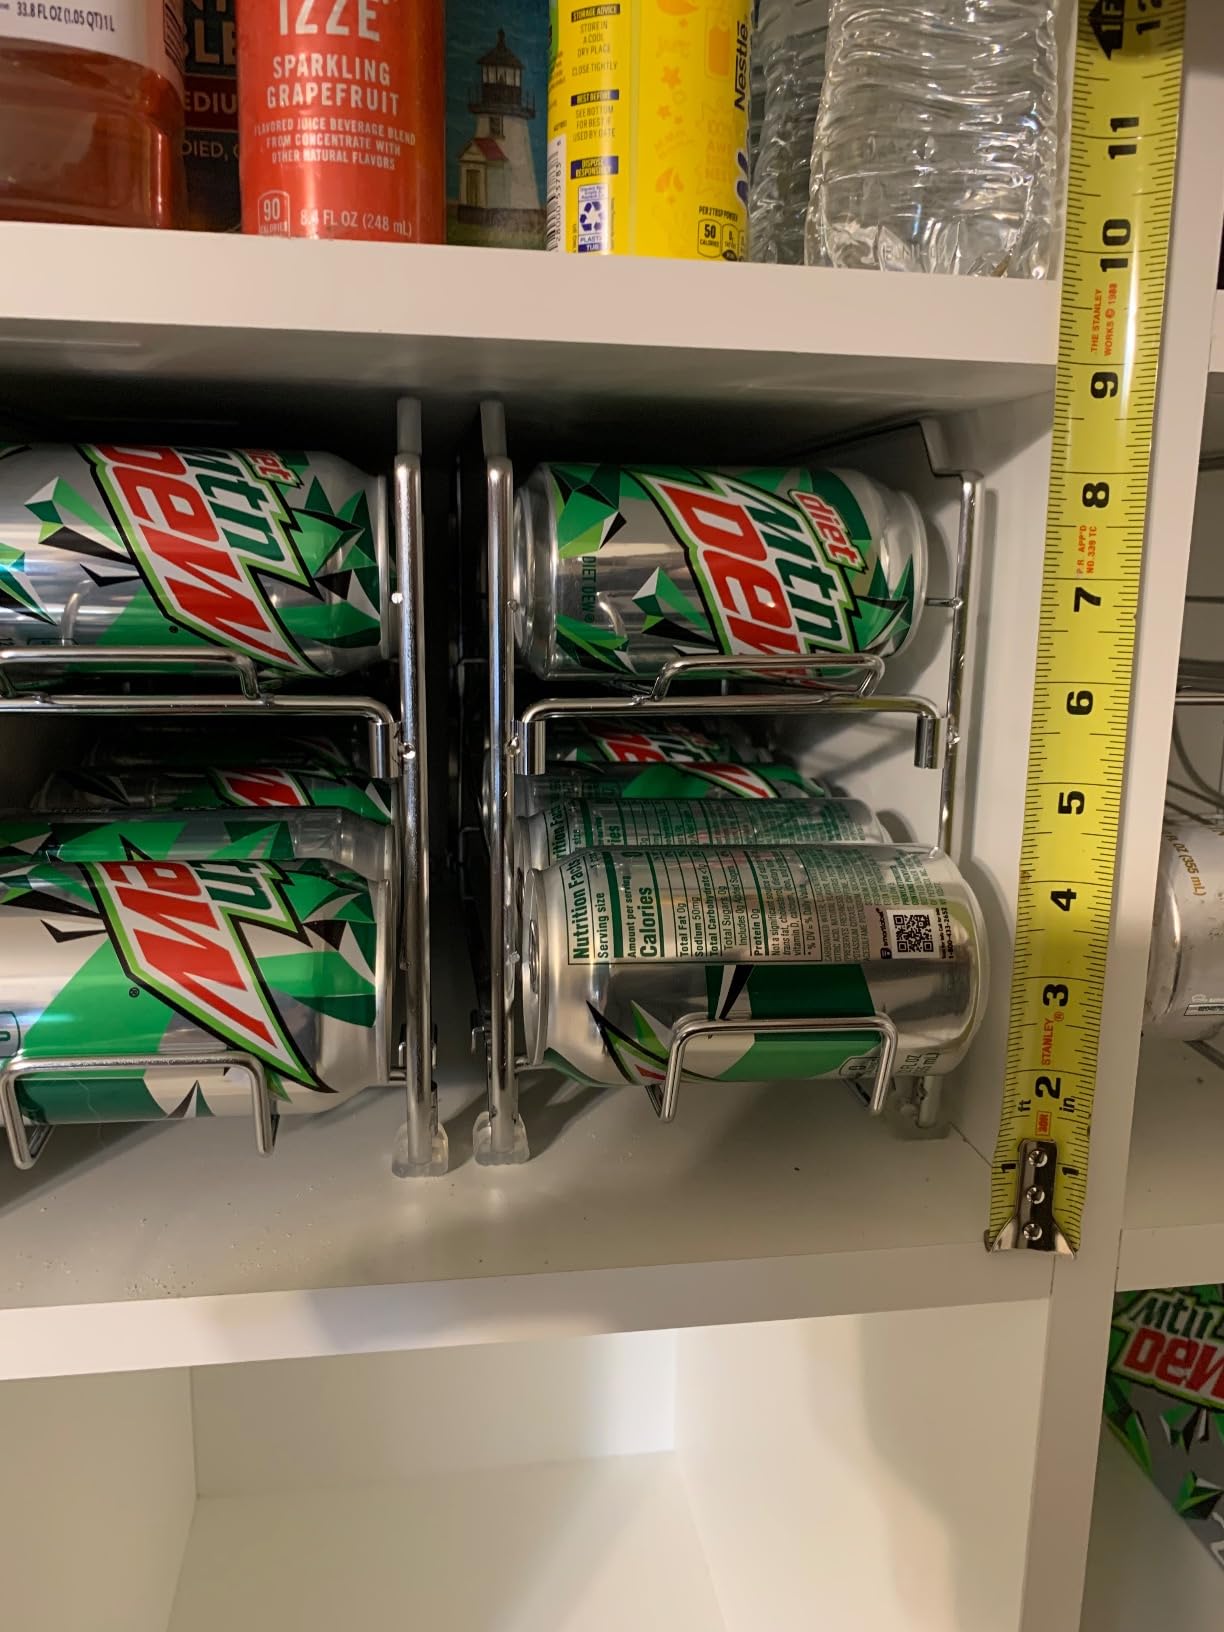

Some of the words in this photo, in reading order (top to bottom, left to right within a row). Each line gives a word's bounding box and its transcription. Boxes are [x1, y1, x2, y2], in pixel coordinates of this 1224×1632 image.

[17, 1, 35, 17] 33.8
[37, 3, 48, 20] FL
[49, 5, 62, 22] OZ
[64, 8, 85, 25] (1.05
[597, 4, 617, 15] ADVICE
[577, 46, 589, 58] DRY
[273, 52, 391, 88] SPARKLING
[572, 63, 590, 76] CLOSE
[267, 82, 400, 117] GRAPEFRUIT
[254, 118, 293, 137] FLAVORED
[298, 117, 326, 131] JUICE
[330, 117, 385, 136] BEVERAGE
[387, 127, 417, 147] BLEND
[576, 119, 587, 128] FOR
[266, 134, 292, 149] FROM
[295, 132, 371, 150] CONCENTRATE
[375, 139, 402, 157] WITH
[1108, 116, 1140, 160] 11
[271, 151, 300, 165] OTHER
[303, 148, 348, 163] NATURAL
[352, 151, 396, 171] FLAVORS
[263, 198, 281, 222] 90
[323, 208, 339, 226] FL
[341, 211, 359, 228] OZ
[362, 213, 389, 232] (248
[393, 220, 413, 238] mL)
[704, 223, 716, 239] 50
[1099, 218, 1131, 273] 10
[1093, 289, 1102, 332] STANLEY
[1091, 333, 1100, 353] THE
[1104, 320, 1114, 357] WORKS
[1090, 371, 1118, 399] 9
[1081, 481, 1110, 509] 8
[582, 556, 596, 583] DIET
[582, 586, 596, 612] DEW
[1073, 587, 1101, 613] 7
[1066, 690, 1094, 716] 6
[1057, 790, 1086, 815] 5
[568, 858, 585, 887] Facts
[1178, 854, 1199, 874] (355
[1190, 876, 1207, 897] mL)
[622, 875, 633, 908] serving
[717, 885, 728, 895] 0g
[1050, 888, 1078, 912] 4
[596, 892, 605, 914] size
[675, 902, 687, 916] 0g
[691, 896, 701, 925] 50mg
[702, 873, 717, 937] Carbohydrate
[720, 895, 732, 932] Sugars
[750, 908, 761, 921] 0g
[571, 888, 590, 959] Nutrition
[626, 909, 637, 924] per
[637, 887, 657, 958] Calories
[678, 917, 688, 935] Fat
[768, 900, 780, 936] significant
[597, 915, 610, 959] Serving
[626, 925, 637, 959] Amount
[694, 926, 704, 958] Sodium
[723, 932, 733, 950] Total
[737, 913, 748, 946] Includes
[752, 922, 764, 957] Protein
[806, 931, 816, 941] DV
[679, 936, 689, 958] Total
[709, 937, 719, 957] Total
[771, 943, 780, 956] Not
[780, 937, 791, 956] trans
[790, 929, 802, 956] vitamin
[1042, 983, 1069, 1007] 3
[1041, 1018, 1055, 1066] STANLEY
[1035, 1076, 1061, 1099] 2
[1018, 1099, 1031, 1112] ft
[1060, 1098, 1075, 1113] in
[1001, 1163, 1017, 1173] 1
[1062, 1166, 1080, 1176] 1
